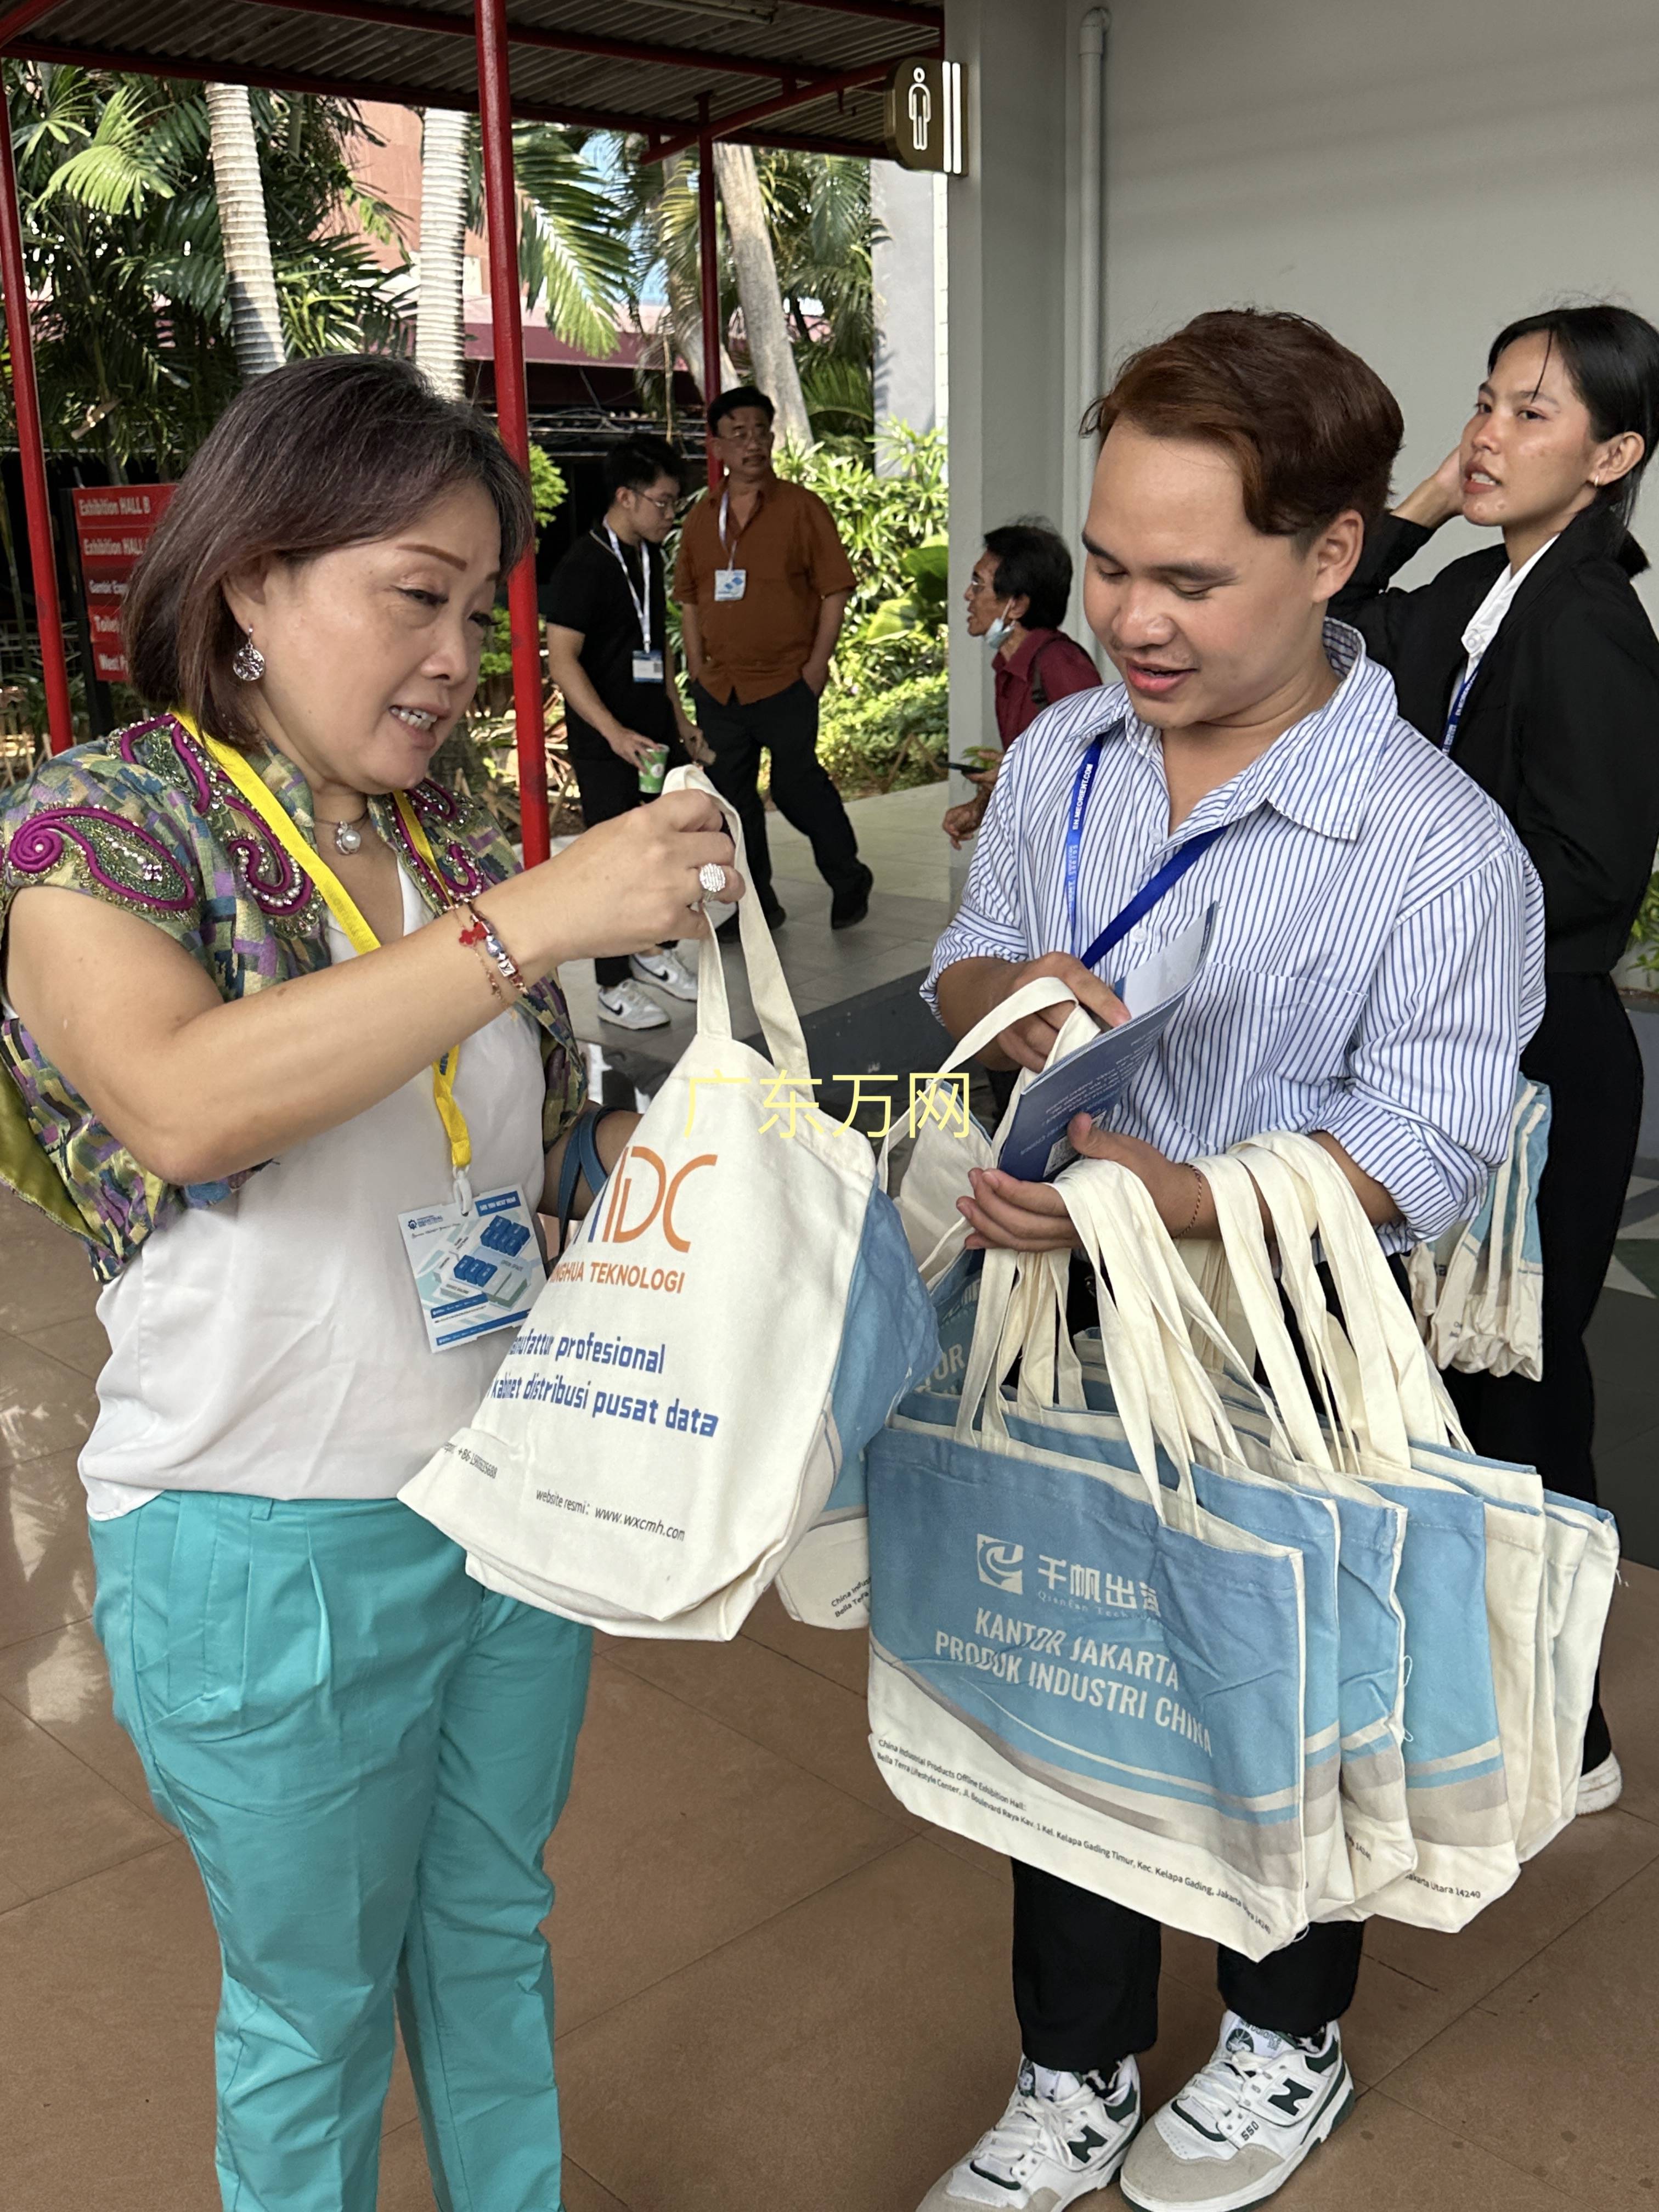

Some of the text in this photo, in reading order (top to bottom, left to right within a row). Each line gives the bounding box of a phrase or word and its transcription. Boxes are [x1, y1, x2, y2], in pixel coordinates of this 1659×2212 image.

[119, 496, 143, 515] HALL
[590, 1261, 686, 1294] TEKNOLOGI
[555, 1331, 665, 1374] profesional
[523, 1372, 591, 1409] distribusi
[592, 1390, 659, 1425] pusat
[665, 1397, 719, 1438] data
[536, 1488, 563, 1508] website
[595, 1506, 685, 1542] www.wxcmh.com
[831, 1592, 851, 1606] China
[835, 1603, 852, 1617] Bella
[975, 1607, 1179, 1691] KANTOR JAKARTA
[935, 1631, 1212, 1758] PRODUK INDUSTRI CHINA
[878, 1739, 898, 1752] China
[899, 1747, 926, 1766] Industrial
[927, 1760, 955, 1779] Products
[956, 1772, 978, 1787] Offline
[979, 1782, 1008, 1804] Exhibition
[877, 1752, 893, 1764] Bella
[894, 1759, 910, 1773] Terra
[1002, 1808, 1019, 1821] Raya
[1057, 1831, 1082, 1847] Kelapa
[1084, 1840, 1110, 1859] Gading
[1155, 1867, 1183, 1884] Kelapa
[1431, 1880, 1454, 1894] Utara
[1455, 1887, 1481, 1899] 14240
[1240, 2120, 1260, 2141] 550
